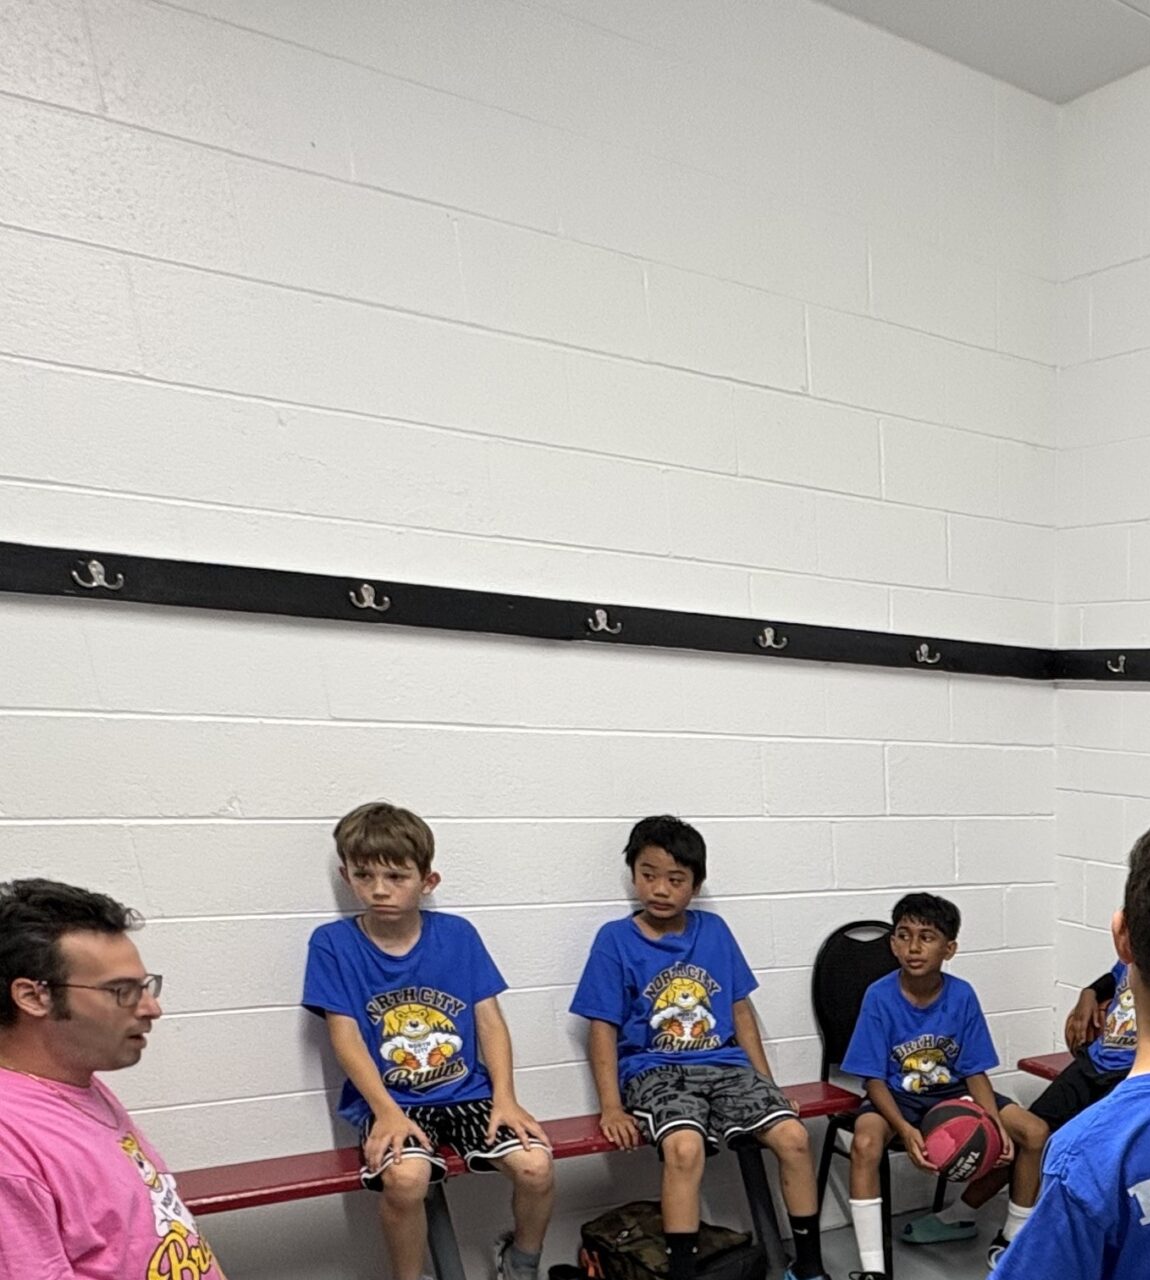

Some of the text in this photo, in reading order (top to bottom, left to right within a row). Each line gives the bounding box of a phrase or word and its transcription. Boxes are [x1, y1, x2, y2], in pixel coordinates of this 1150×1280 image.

[366, 986, 467, 1025] NRTH CITY
[651, 1030, 722, 1054] Bruins
[383, 1057, 468, 1091] Bruins
